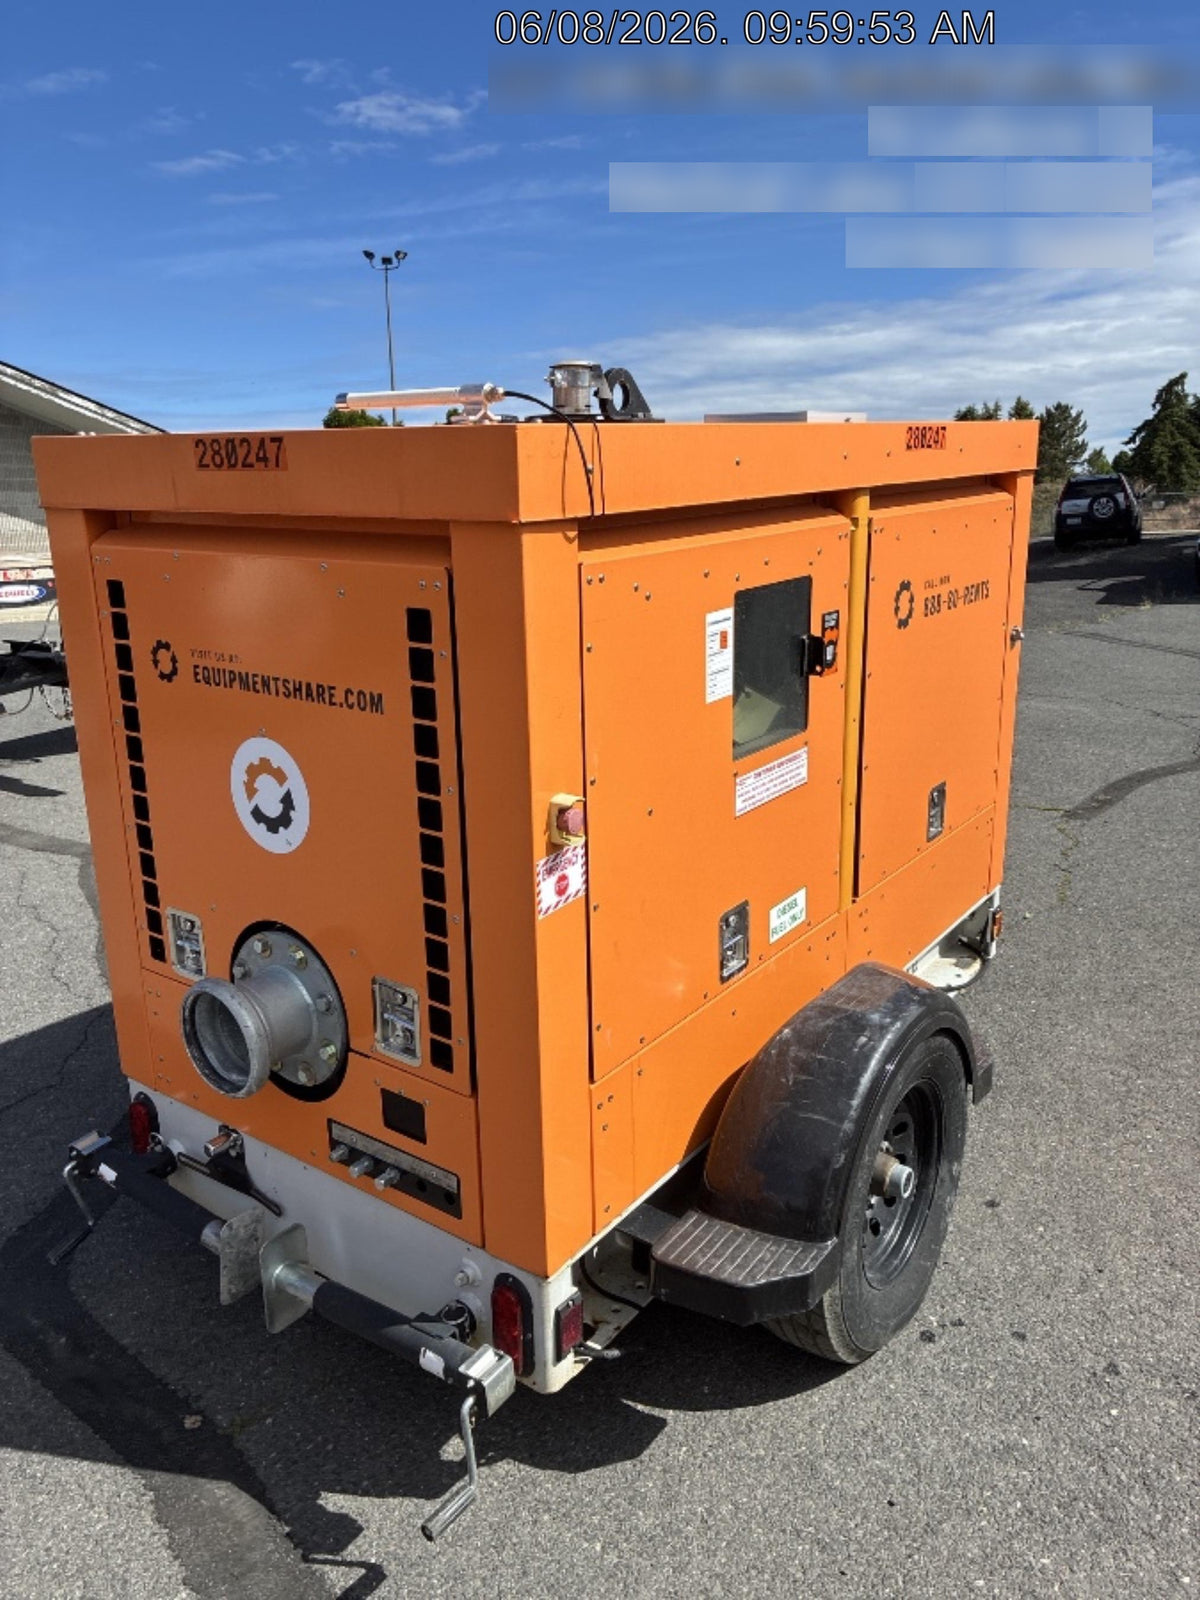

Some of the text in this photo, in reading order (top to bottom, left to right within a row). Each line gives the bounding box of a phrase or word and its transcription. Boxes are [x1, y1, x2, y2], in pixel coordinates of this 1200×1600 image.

[194, 436, 285, 469] 280247
[906, 426, 946, 450] 280247
[192, 664, 384, 716] EQUIPMENTSHARE.COM
